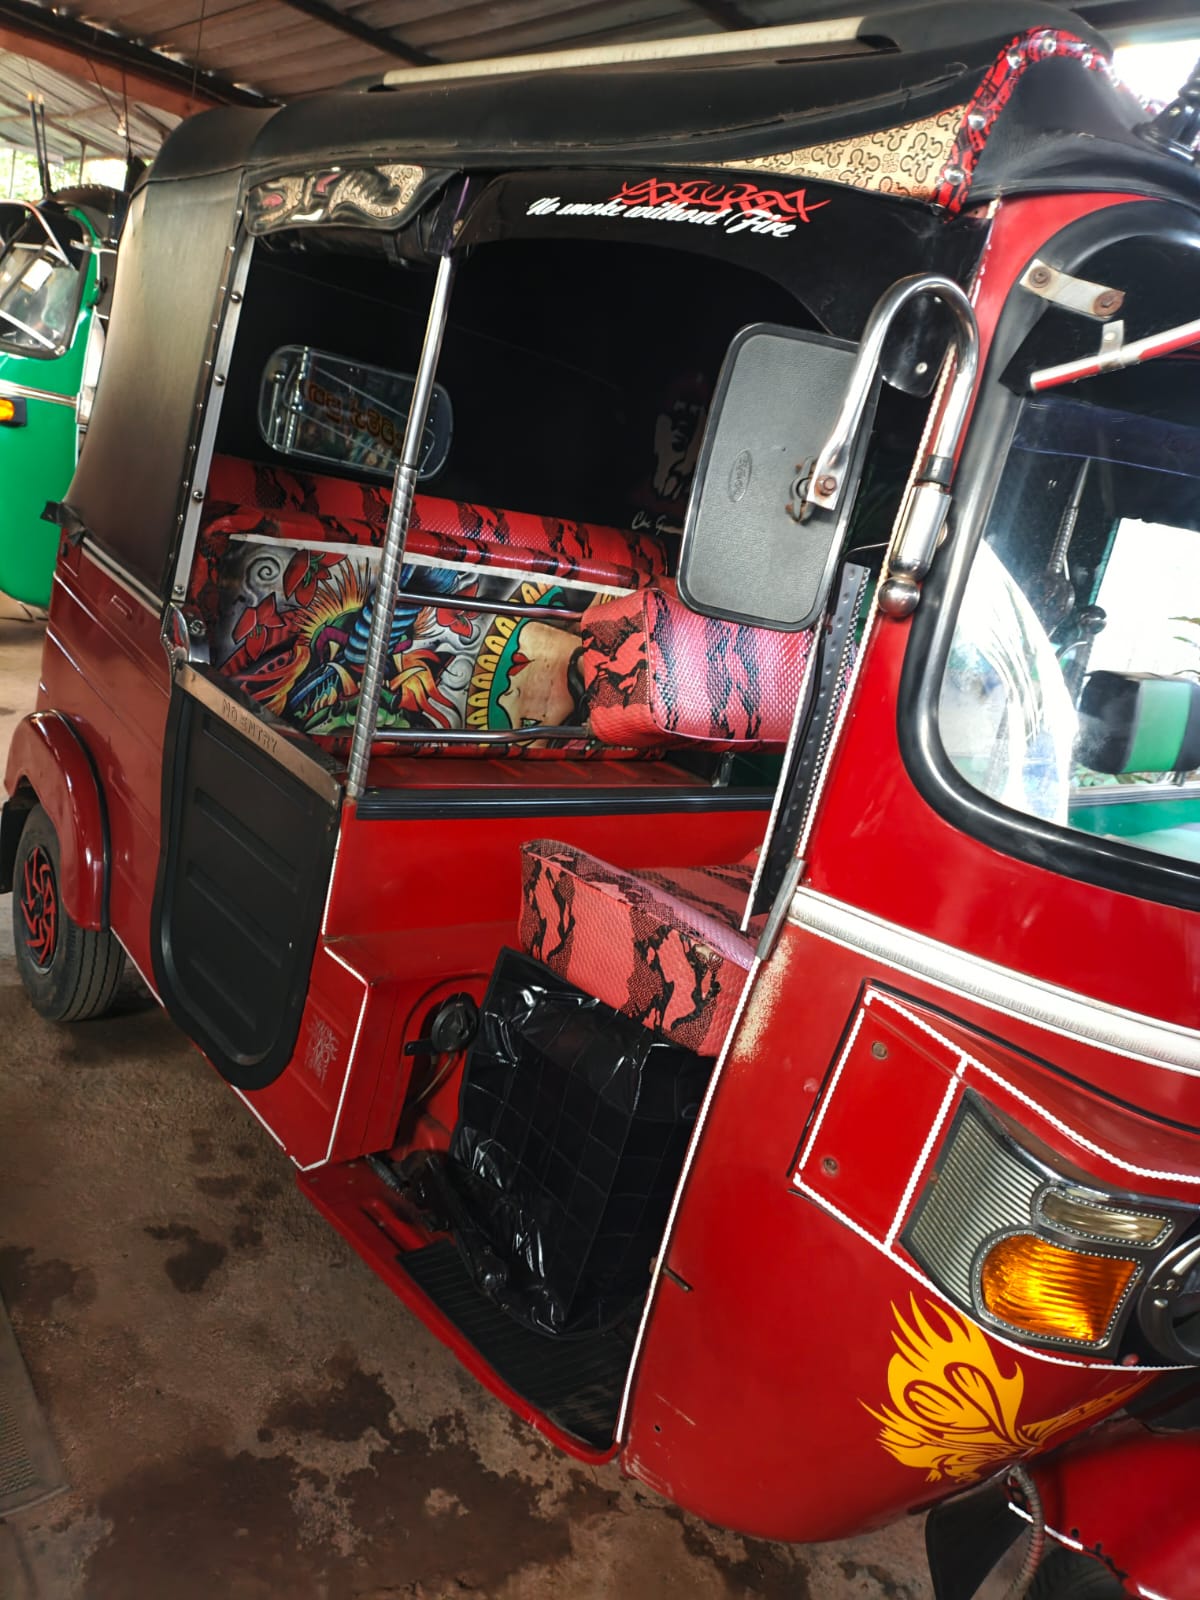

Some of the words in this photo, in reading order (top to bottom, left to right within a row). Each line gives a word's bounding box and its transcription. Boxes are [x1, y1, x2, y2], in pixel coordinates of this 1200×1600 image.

[556, 198, 622, 217] smoke
[623, 201, 727, 225] without
[724, 209, 797, 238] Fire
[223, 699, 238, 722] NO
[241, 717, 278, 753] ENTRY
